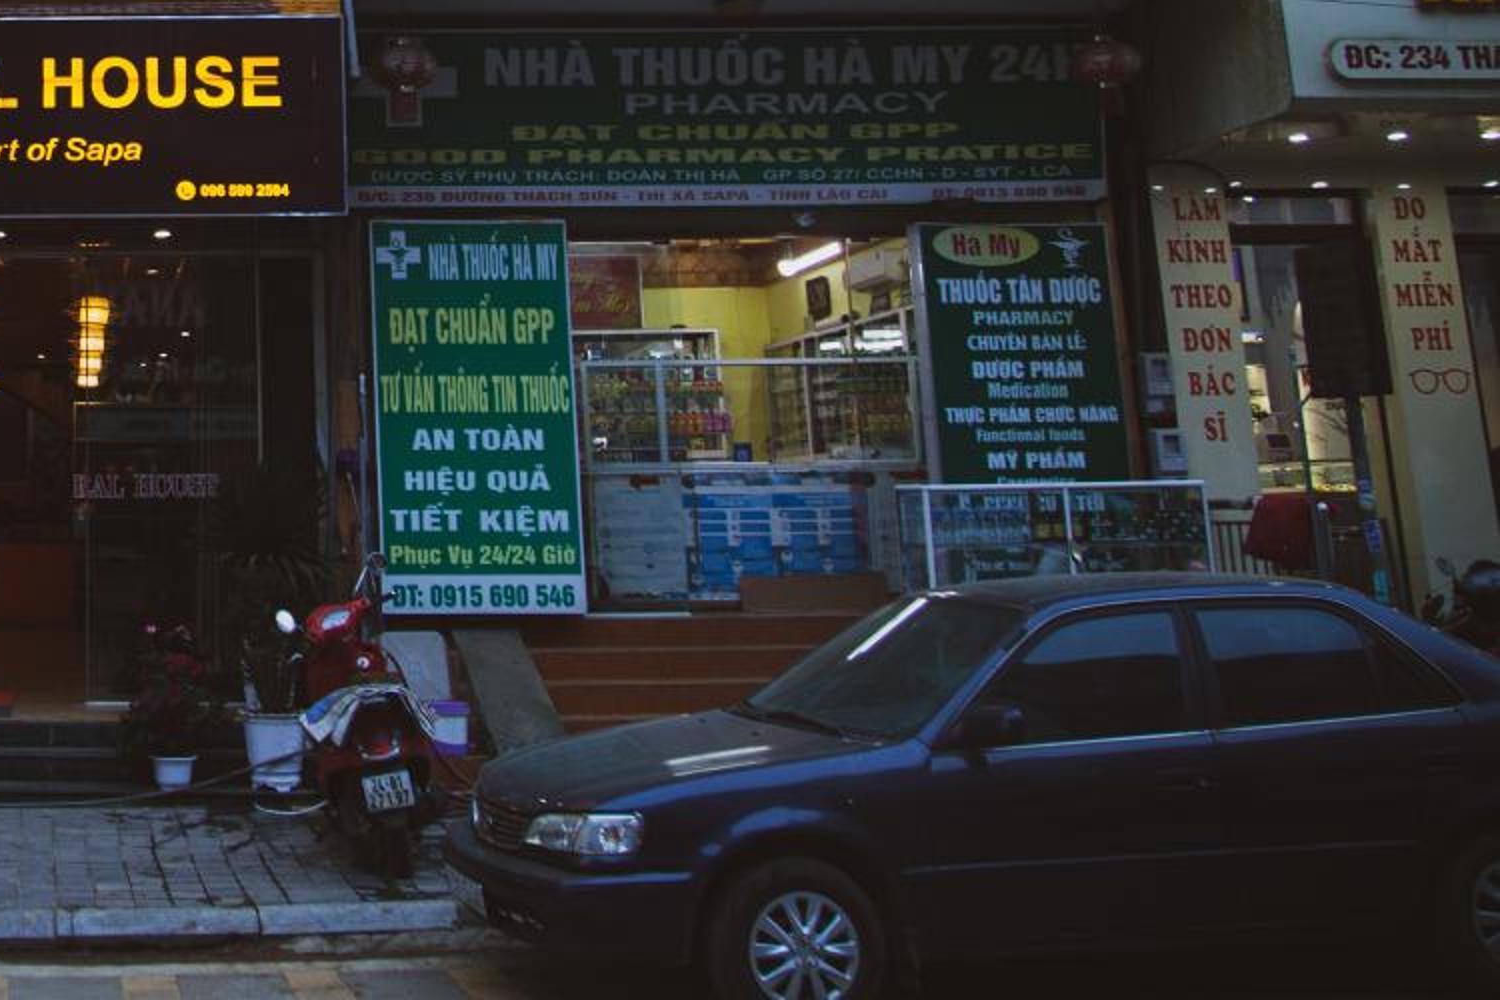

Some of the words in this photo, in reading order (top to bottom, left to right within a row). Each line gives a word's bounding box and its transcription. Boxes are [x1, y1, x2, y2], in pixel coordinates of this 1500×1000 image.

[484, 40, 596, 87] NHÀ
[611, 34, 784, 87] THUỐC
[804, 39, 874, 86] HÀ
[1400, 44, 1449, 70] 234
[42, 55, 283, 110] HOUSE
[626, 93, 948, 115] PHARMACY
[512, 125, 618, 144] ĐẠT
[850, 122, 960, 139] GPP
[26, 137, 60, 163] of
[64, 136, 143, 167] Sapa
[356, 148, 508, 165] GOOD
[528, 146, 844, 164] PHARMACY
[428, 234, 460, 280] NHÀ
[463, 231, 510, 280] THUỐC
[512, 236, 534, 280] HÀ
[536, 244, 558, 280] MY
[989, 231, 1020, 257] My
[1167, 232, 1229, 264] KÍNH
[936, 270, 1003, 304] THUỐC
[1170, 284, 1232, 308] THEO
[1395, 271, 1455, 307] MIỄN
[389, 307, 429, 353] ĐẠT
[435, 292, 508, 345] CHUẨN
[512, 306, 556, 345] GPP
[972, 309, 1075, 326] PHARMACY
[1410, 319, 1453, 351] PHÍ
[403, 360, 435, 413] VẤN
[438, 365, 488, 413] THÔNG
[491, 375, 518, 413] TIN
[520, 360, 570, 413] THUỐC
[1189, 363, 1236, 397] BÁC
[412, 428, 456, 451] AN
[464, 422, 546, 451] TOÀN
[404, 465, 477, 496] HIỆU
[389, 501, 464, 533] TIẾT
[479, 504, 571, 537] KIỆM
[389, 545, 442, 569] Phục
[447, 545, 474, 569] Vụ
[479, 545, 537, 566] 24/24
[392, 585, 423, 608] ĐT:
[430, 585, 484, 608] 0915
[490, 584, 529, 608] 690
[536, 584, 576, 608] 546
